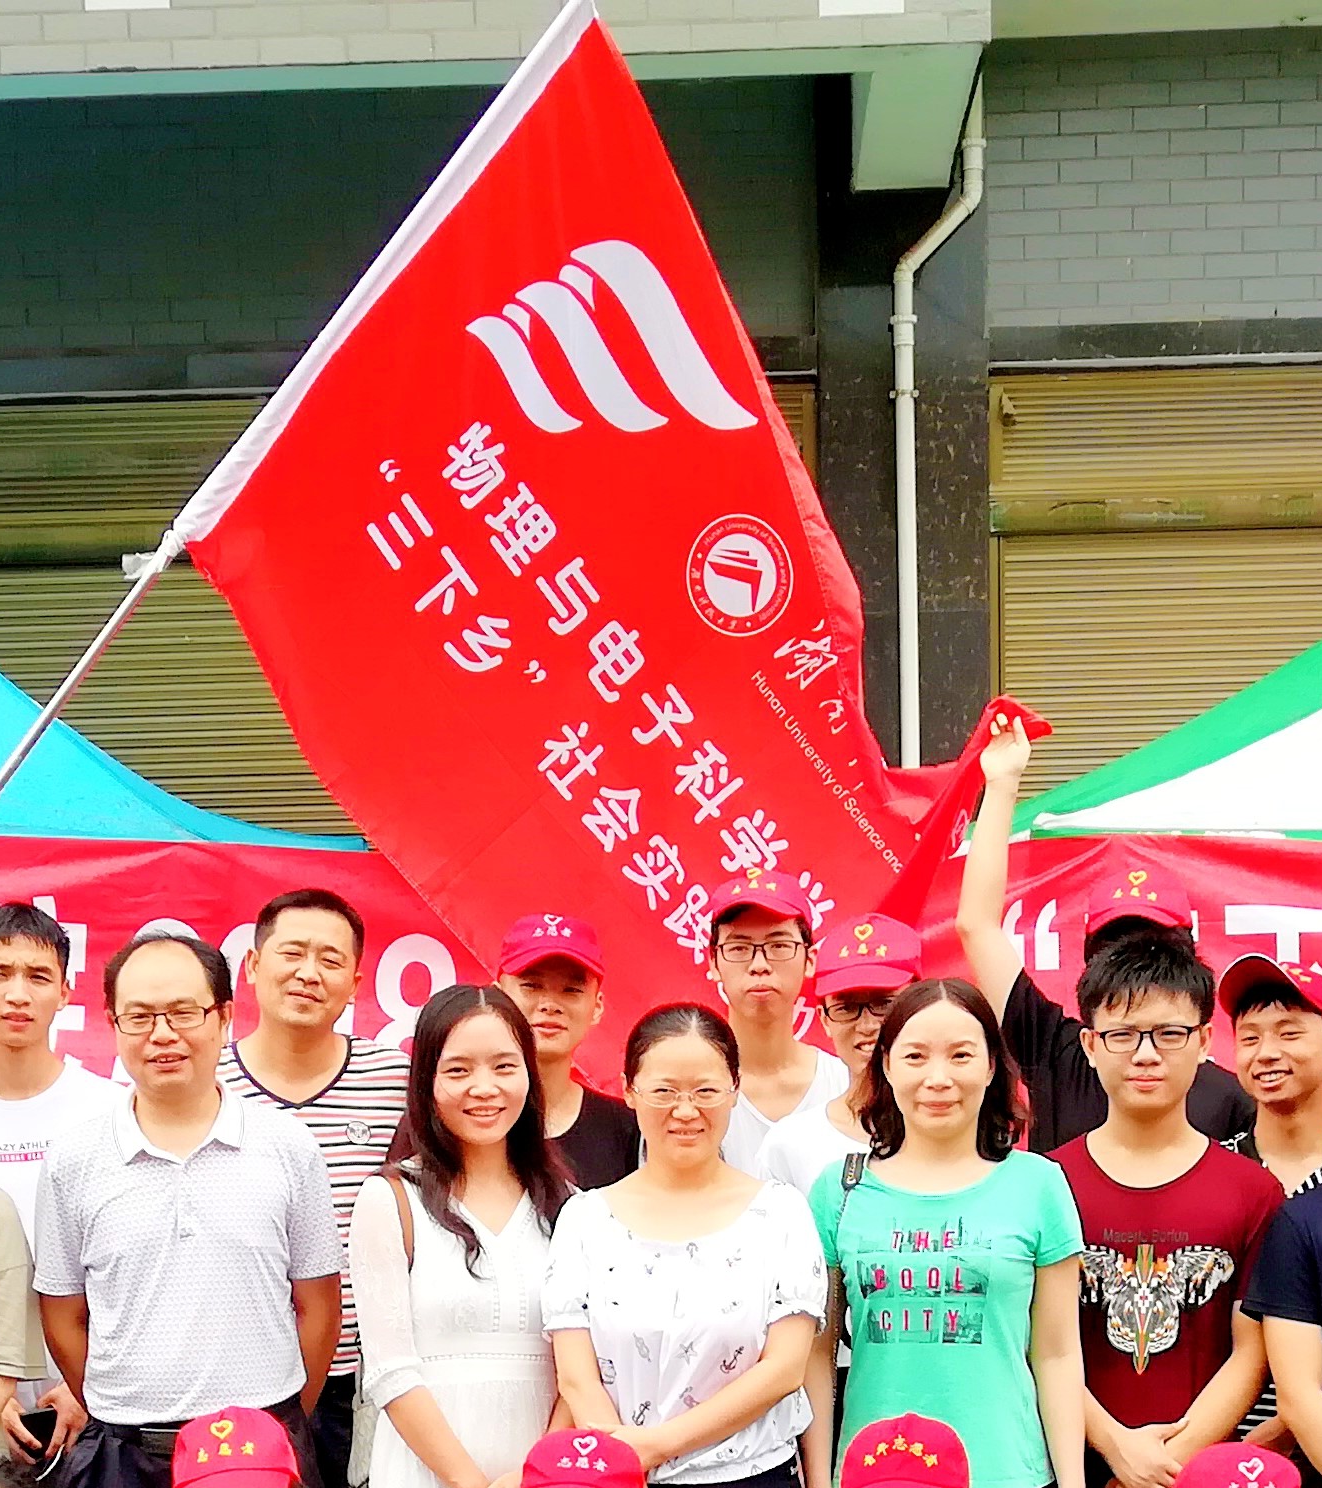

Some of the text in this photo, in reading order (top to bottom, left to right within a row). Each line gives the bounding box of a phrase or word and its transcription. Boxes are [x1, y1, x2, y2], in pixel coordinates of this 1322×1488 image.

[751, 670, 787, 719] Hunan
[784, 715, 837, 786] University
[832, 782, 851, 800] of
[843, 797, 887, 851] Science
[18, 1139, 54, 1151] ATHLE
[892, 1230, 956, 1249] THE
[879, 1308, 960, 1333] CITY
